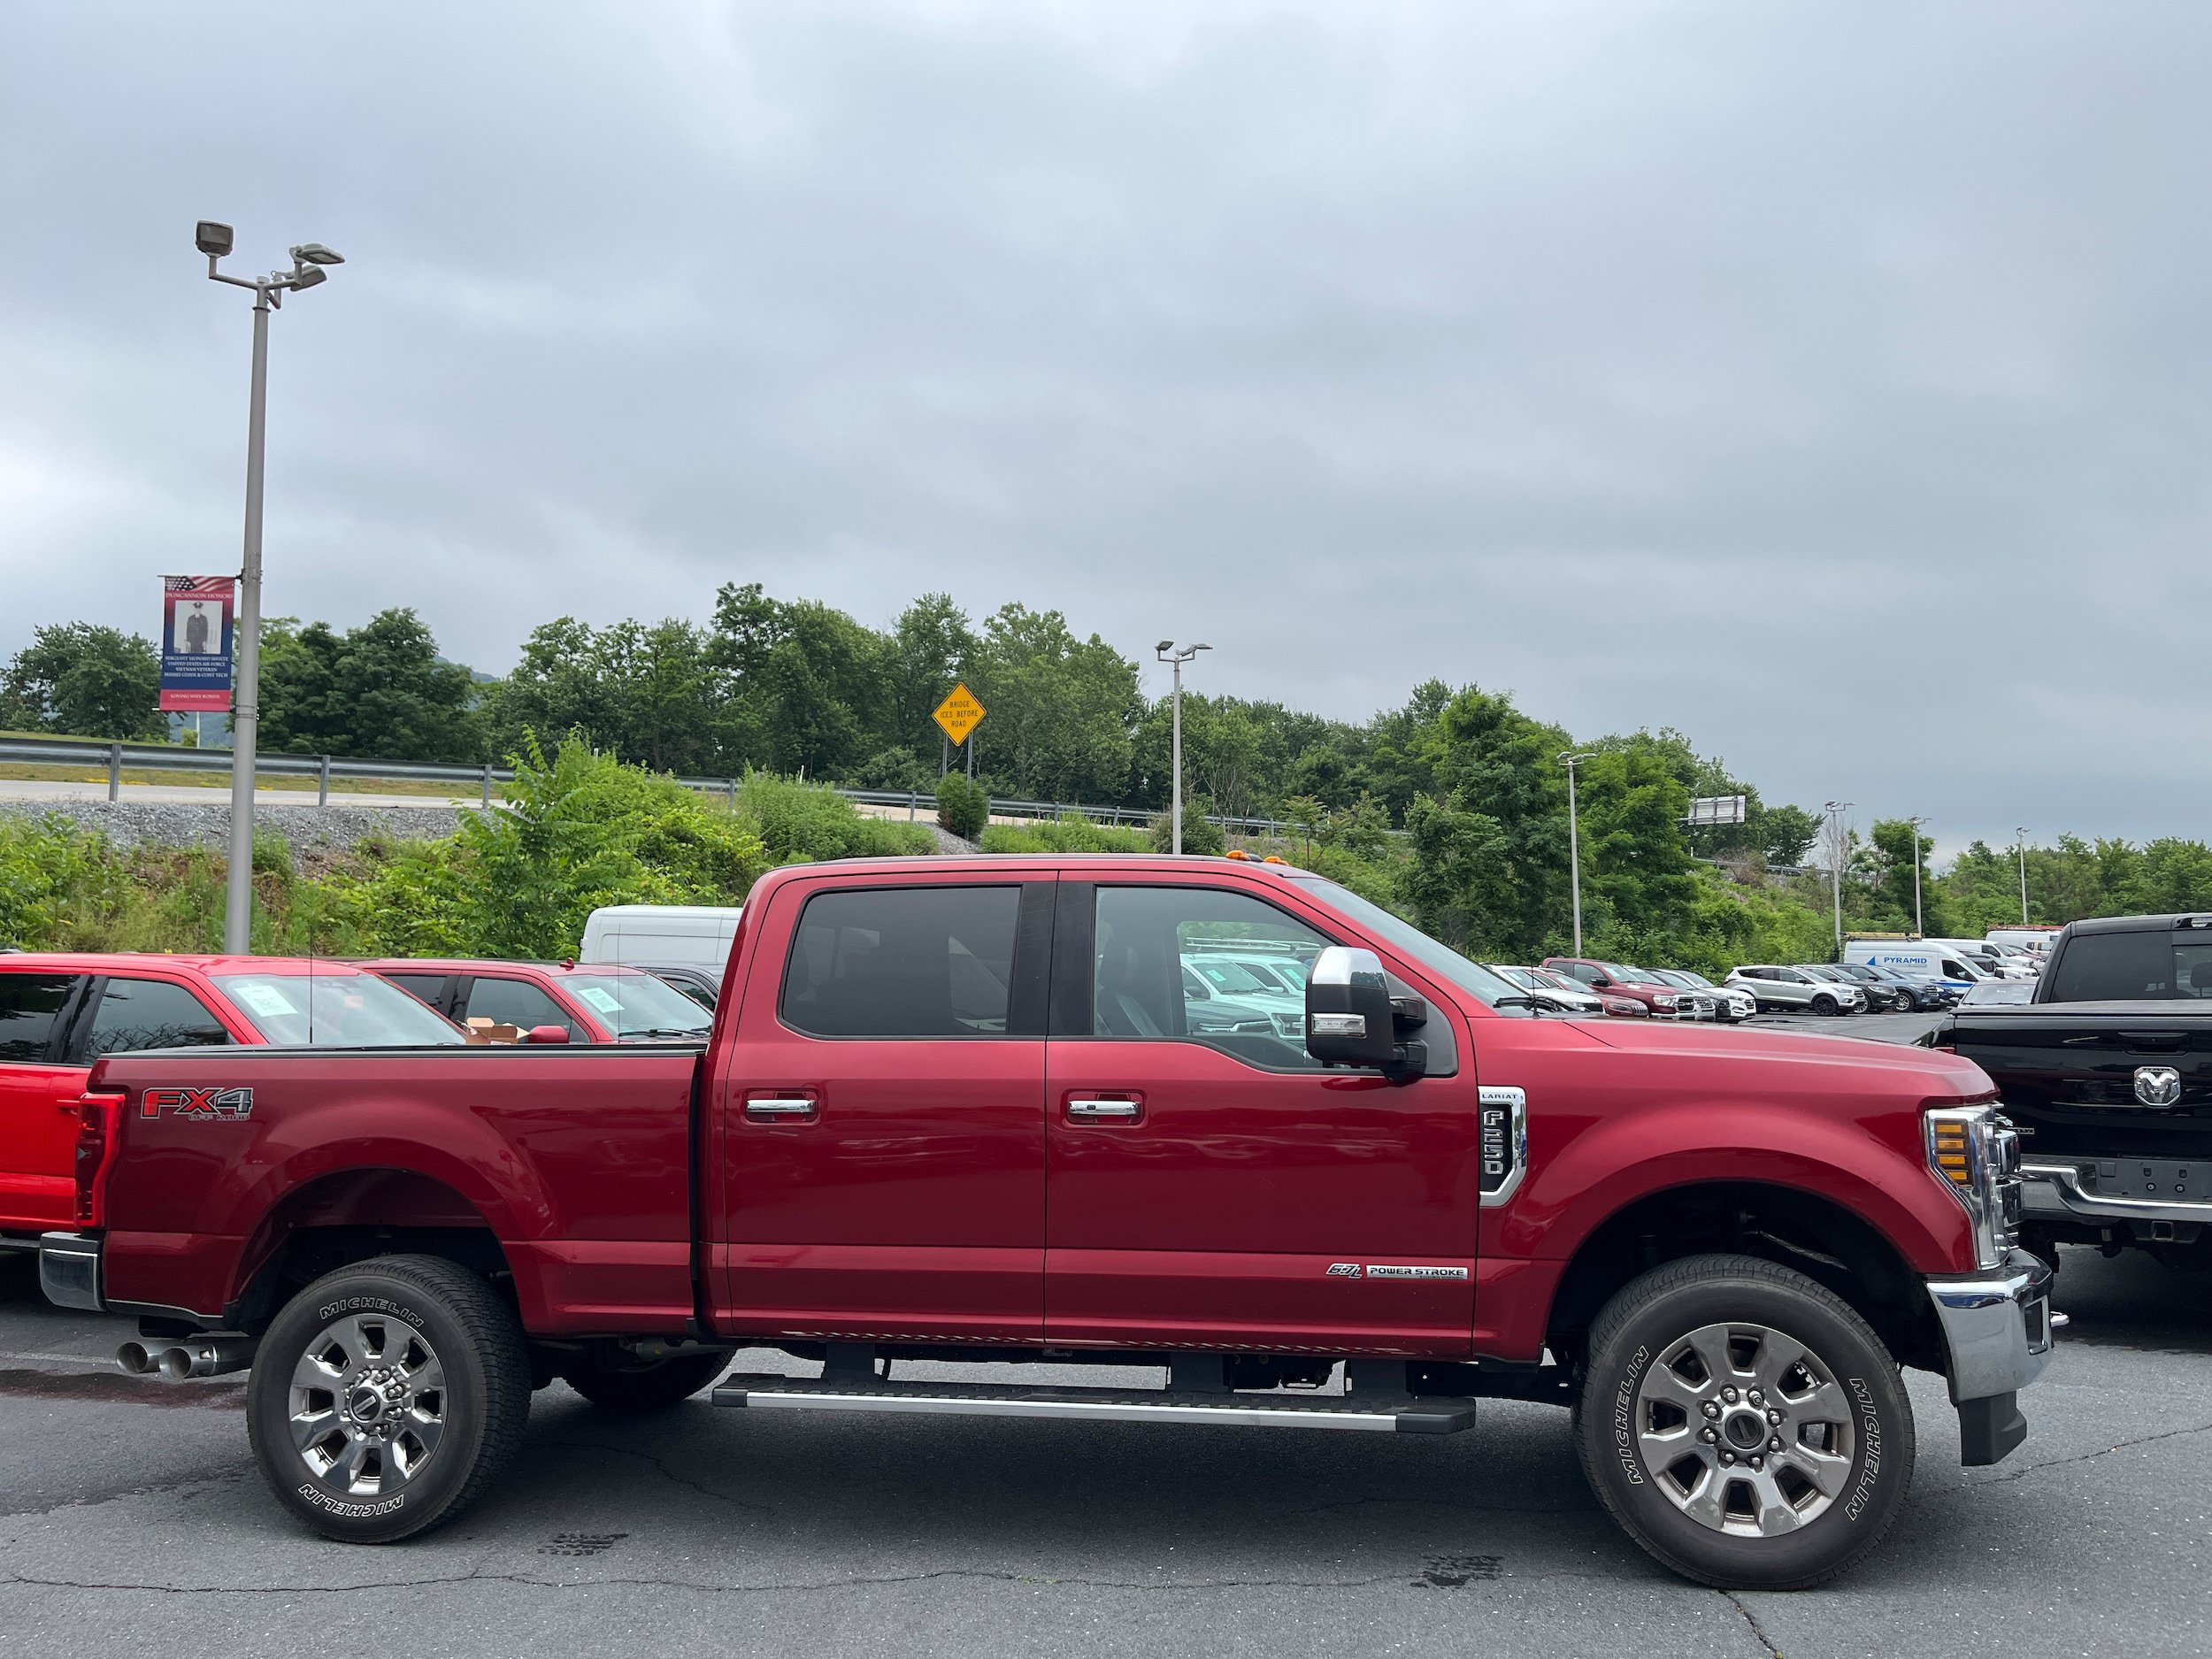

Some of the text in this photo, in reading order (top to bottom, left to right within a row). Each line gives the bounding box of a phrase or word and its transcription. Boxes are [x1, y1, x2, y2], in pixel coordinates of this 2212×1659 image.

[140, 1087, 254, 1119] FX4
[1483, 1110, 1504, 1175] F250
[1370, 1267, 1464, 1276] POWER STROKE
[319, 1296, 426, 1328] MICHELIN
[1614, 1345, 1650, 1485] MICHELIN
[1844, 1376, 1881, 1522] MICHELIN
[297, 1483, 405, 1517] MICHELIN
